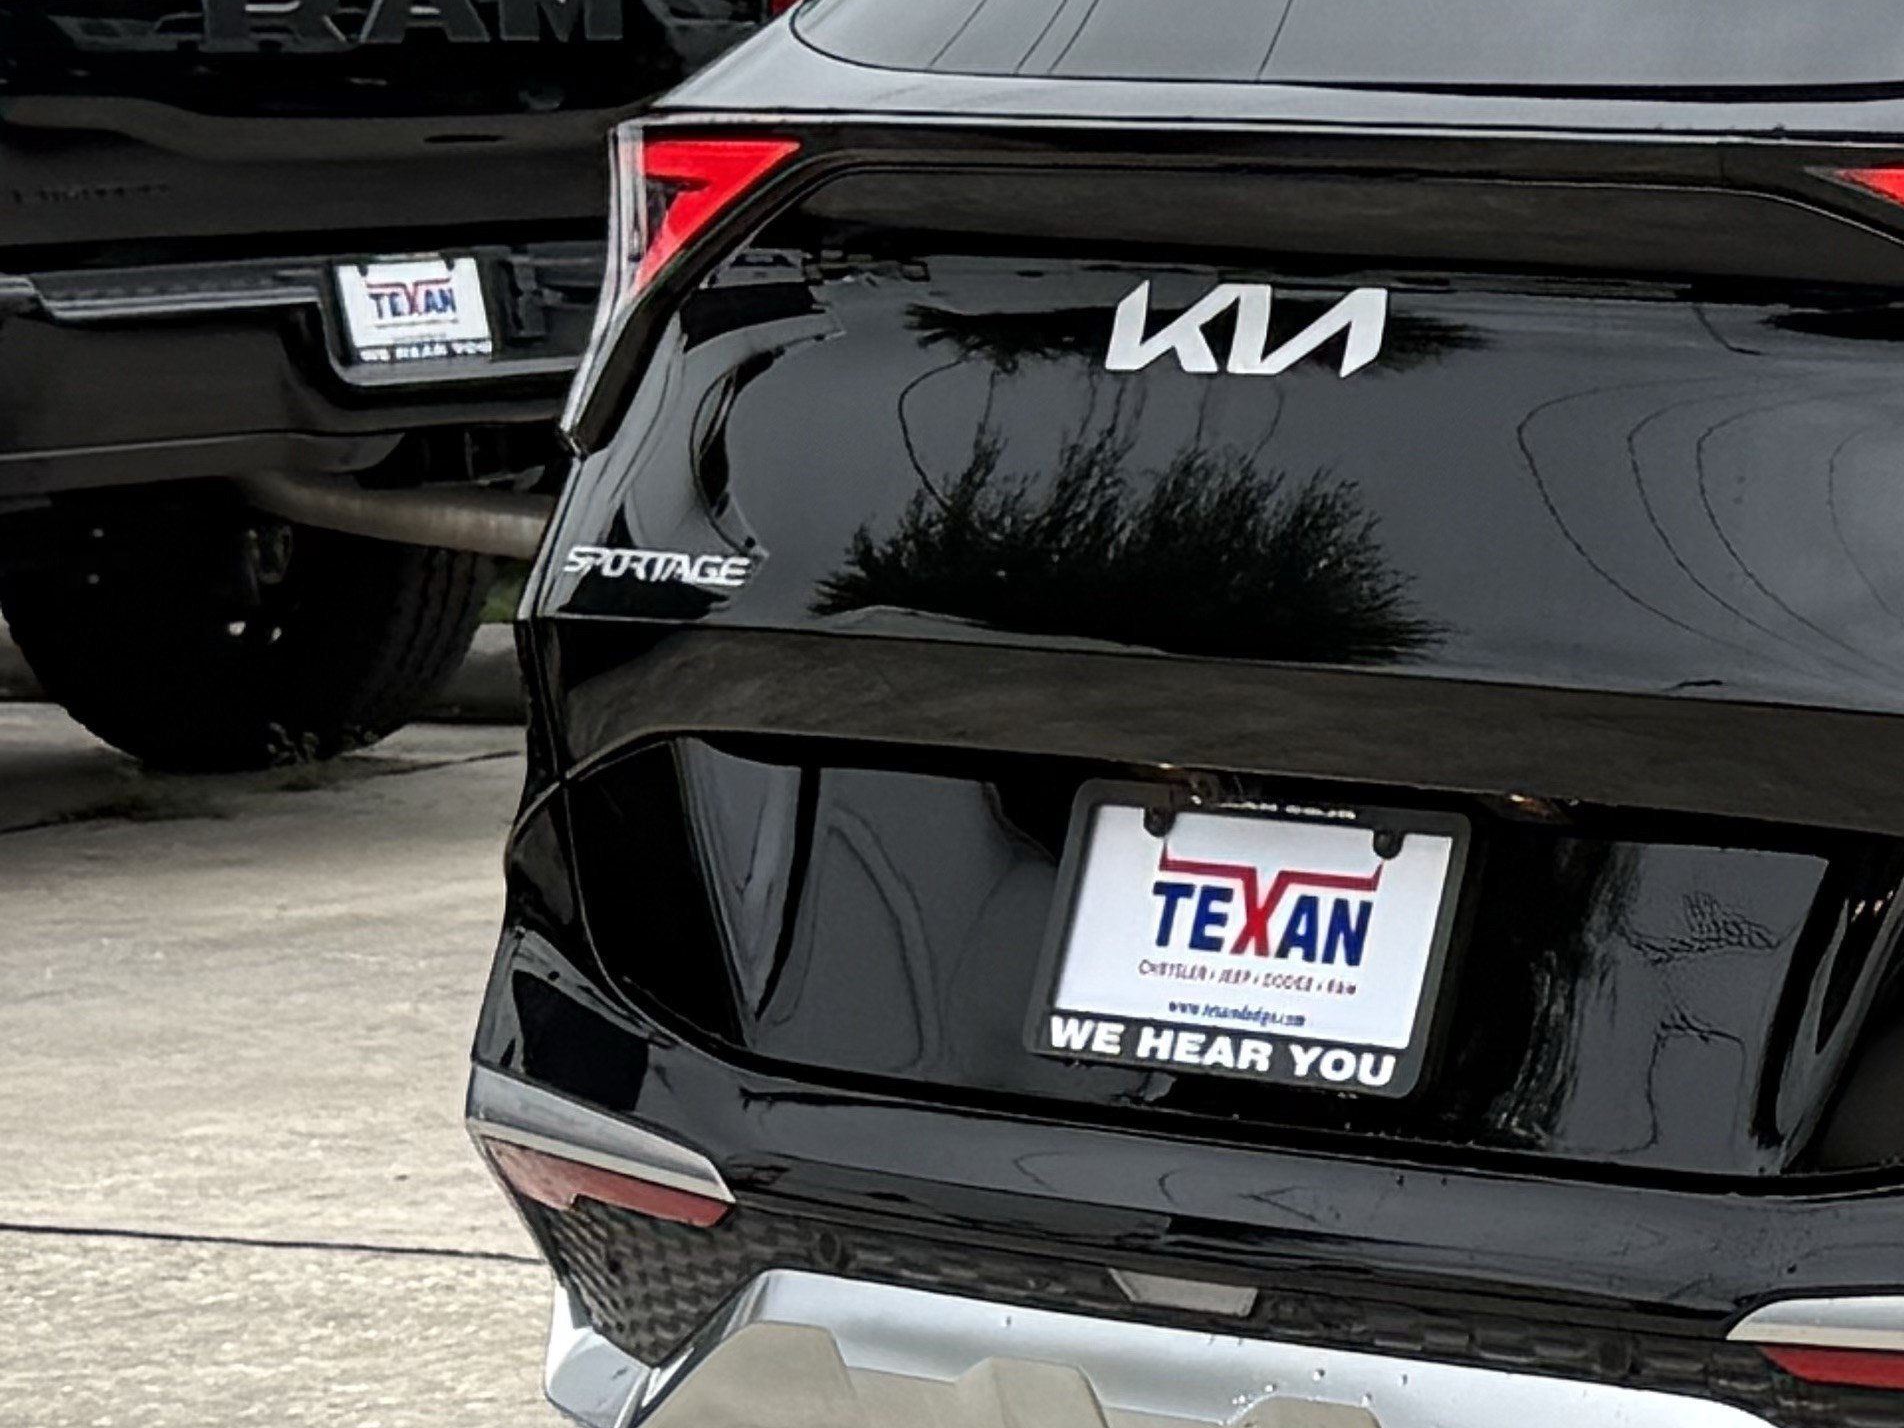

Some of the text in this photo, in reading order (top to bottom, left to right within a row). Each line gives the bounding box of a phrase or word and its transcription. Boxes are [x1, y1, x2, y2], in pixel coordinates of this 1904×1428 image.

[368, 280, 457, 319] TEXAN
[563, 545, 750, 587] SPORTAGE
[1152, 866, 1374, 967] TEXAN
[1050, 1015, 1397, 1087] WE HEAR YOU
